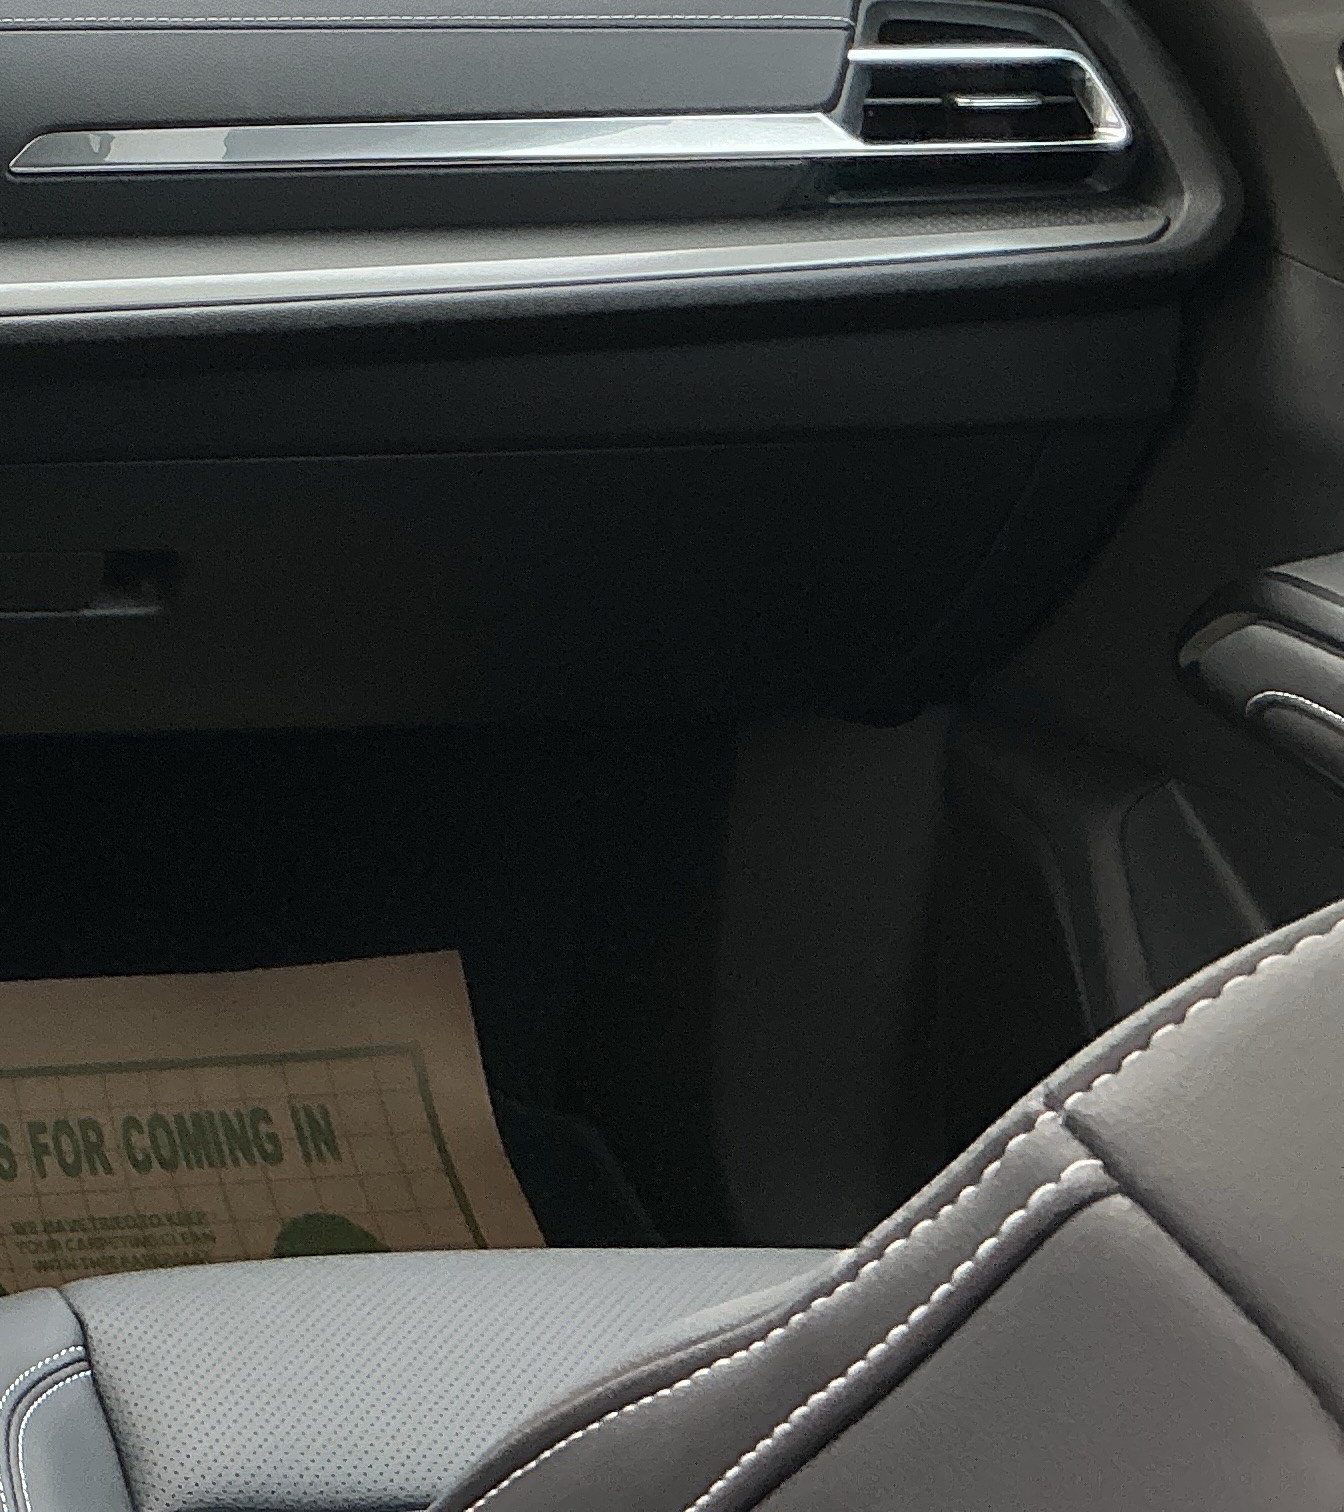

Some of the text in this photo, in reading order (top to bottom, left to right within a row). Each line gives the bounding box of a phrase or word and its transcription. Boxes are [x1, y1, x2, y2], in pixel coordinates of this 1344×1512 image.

[26, 1116, 113, 1179] FOR
[120, 1106, 285, 1175] COMING
[288, 1102, 343, 1165] IN
